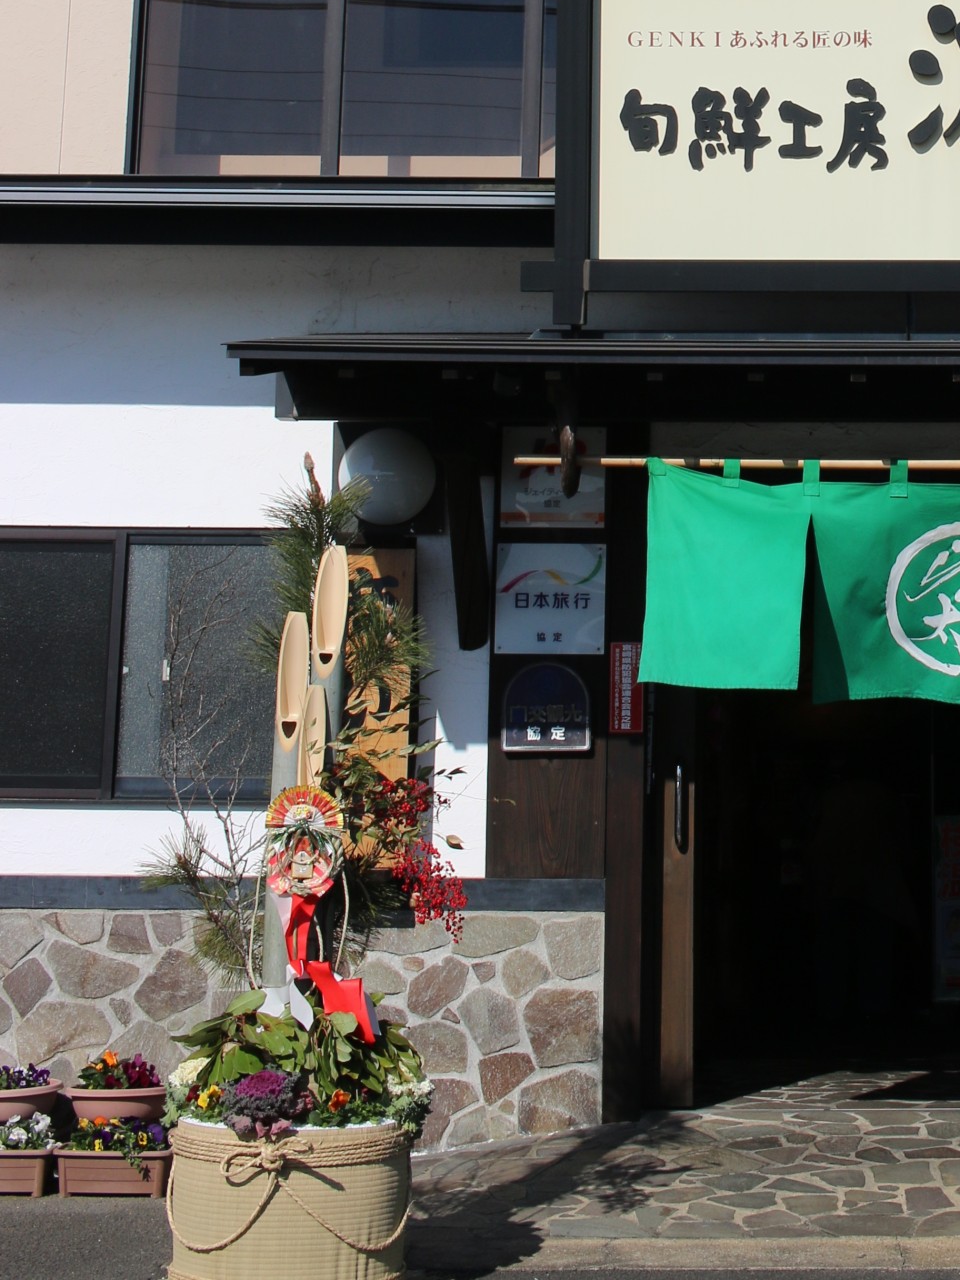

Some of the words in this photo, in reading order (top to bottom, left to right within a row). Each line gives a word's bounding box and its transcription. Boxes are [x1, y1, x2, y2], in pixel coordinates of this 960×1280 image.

[619, 78, 889, 173] 旬鮮工房
[514, 592, 591, 610] 日本旅行
[536, 631, 563, 643] 協定
[527, 725, 566, 741] 協定
